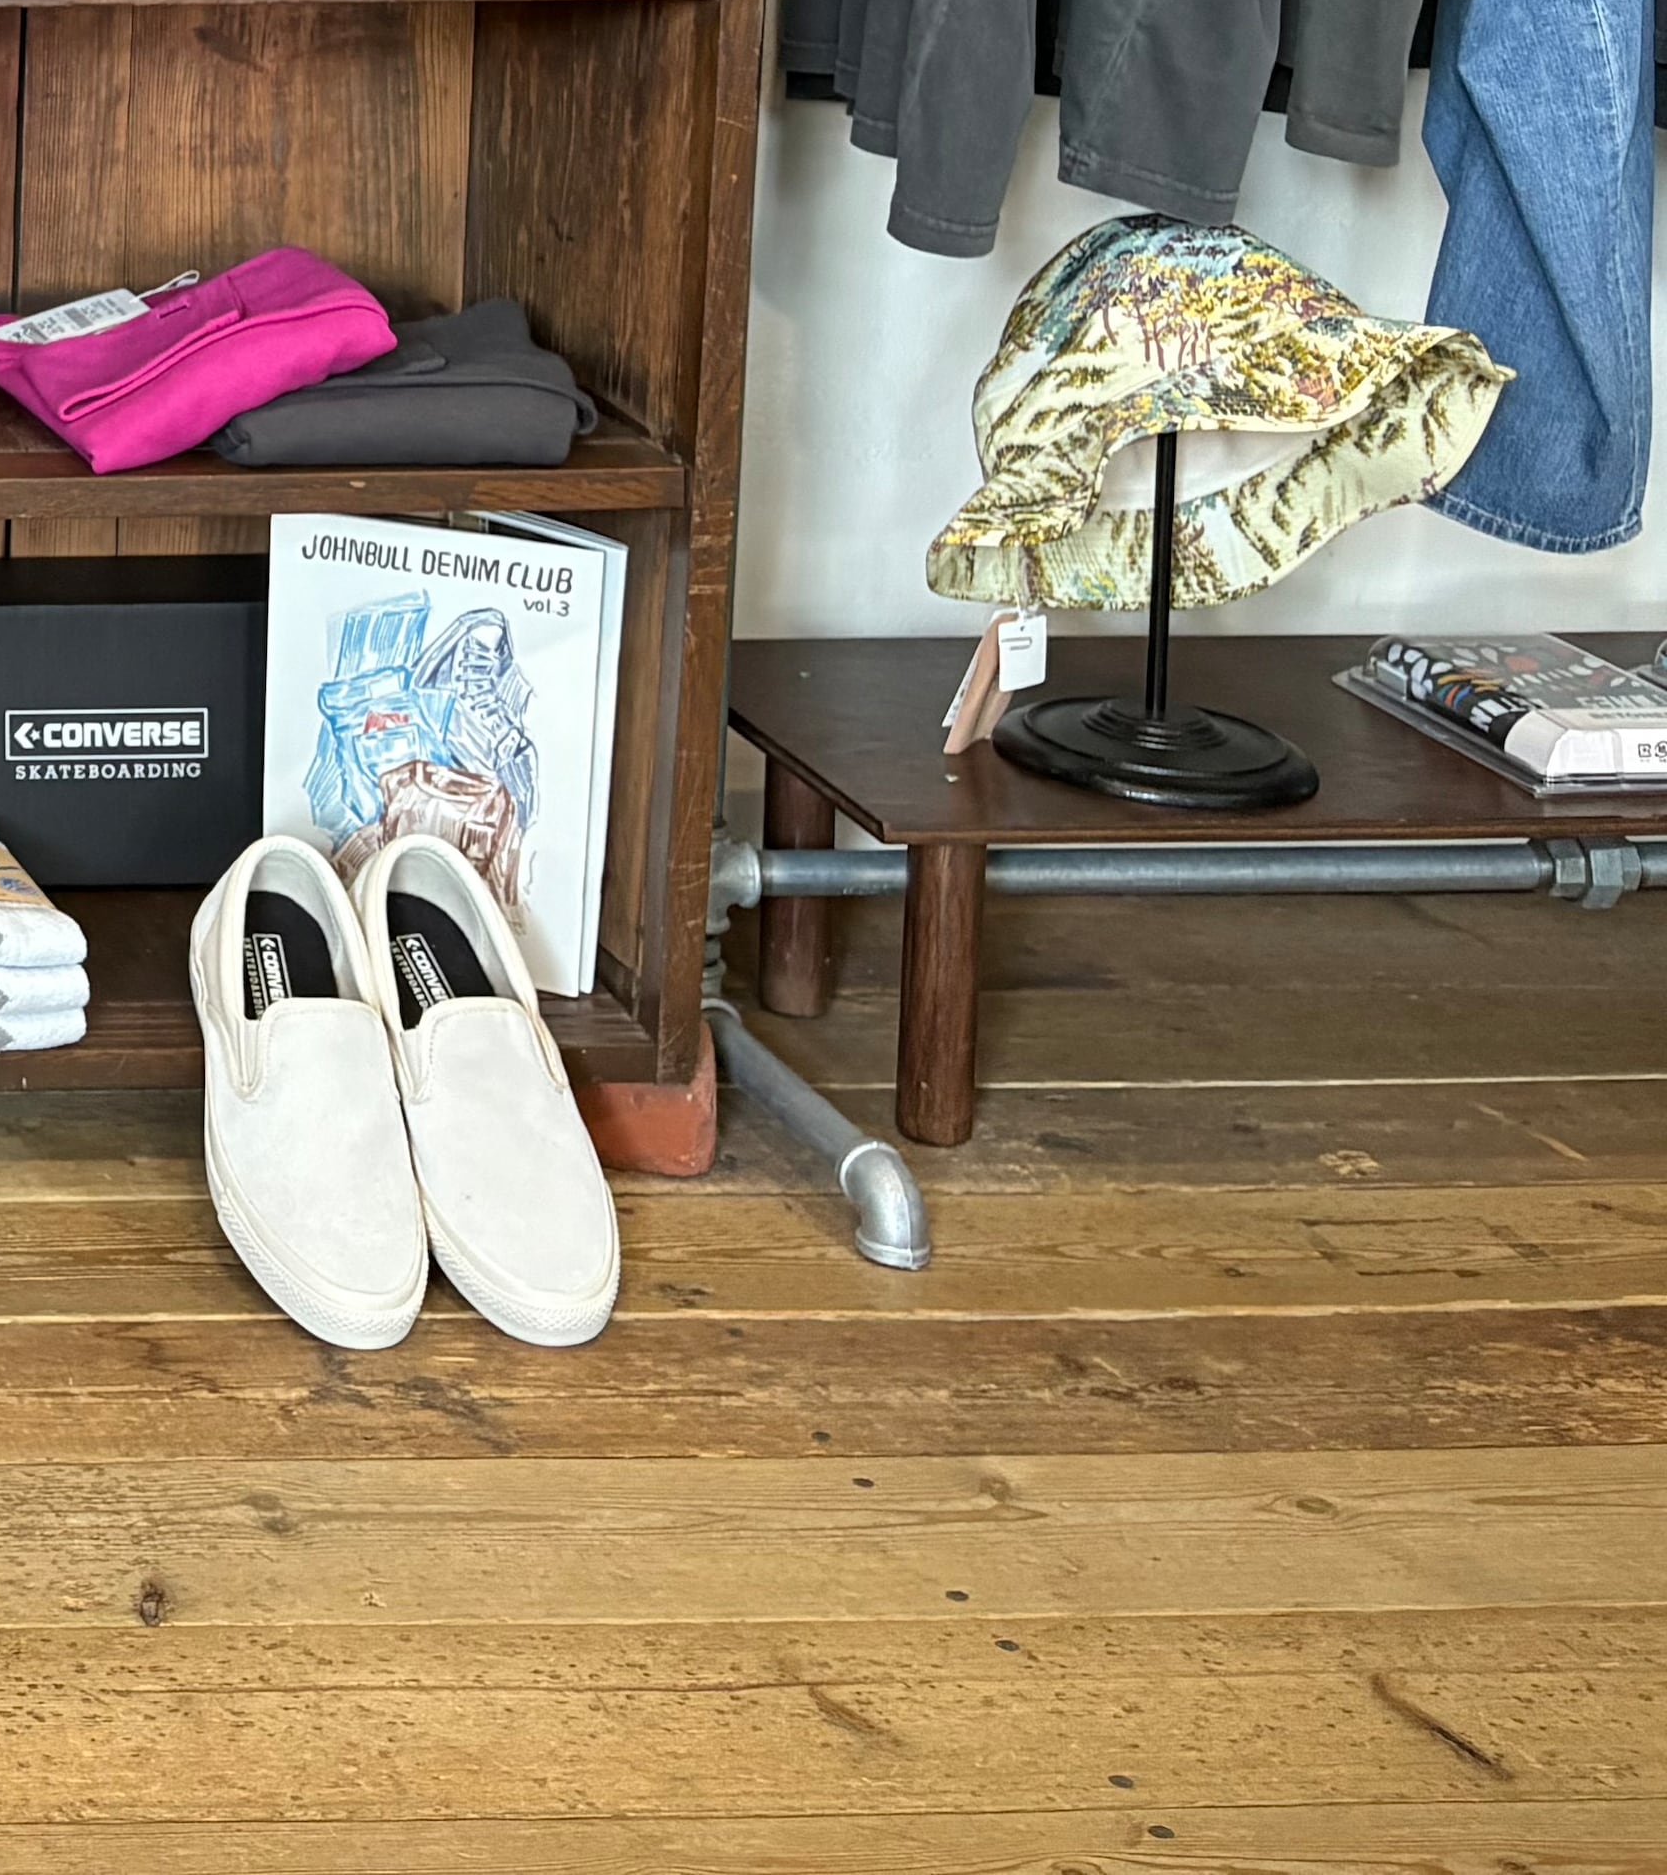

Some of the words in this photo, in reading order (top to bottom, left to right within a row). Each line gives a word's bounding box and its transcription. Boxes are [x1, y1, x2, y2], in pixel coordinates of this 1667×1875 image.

[301, 534, 412, 573] JOHNBULL
[421, 549, 500, 584] DENIM
[506, 562, 573, 594] CLUB
[43, 721, 201, 748] CONVERSE
[15, 762, 202, 780] SKATEBOARDING
[262, 950, 285, 1002] CONVE
[411, 951, 448, 1002] CONVE
